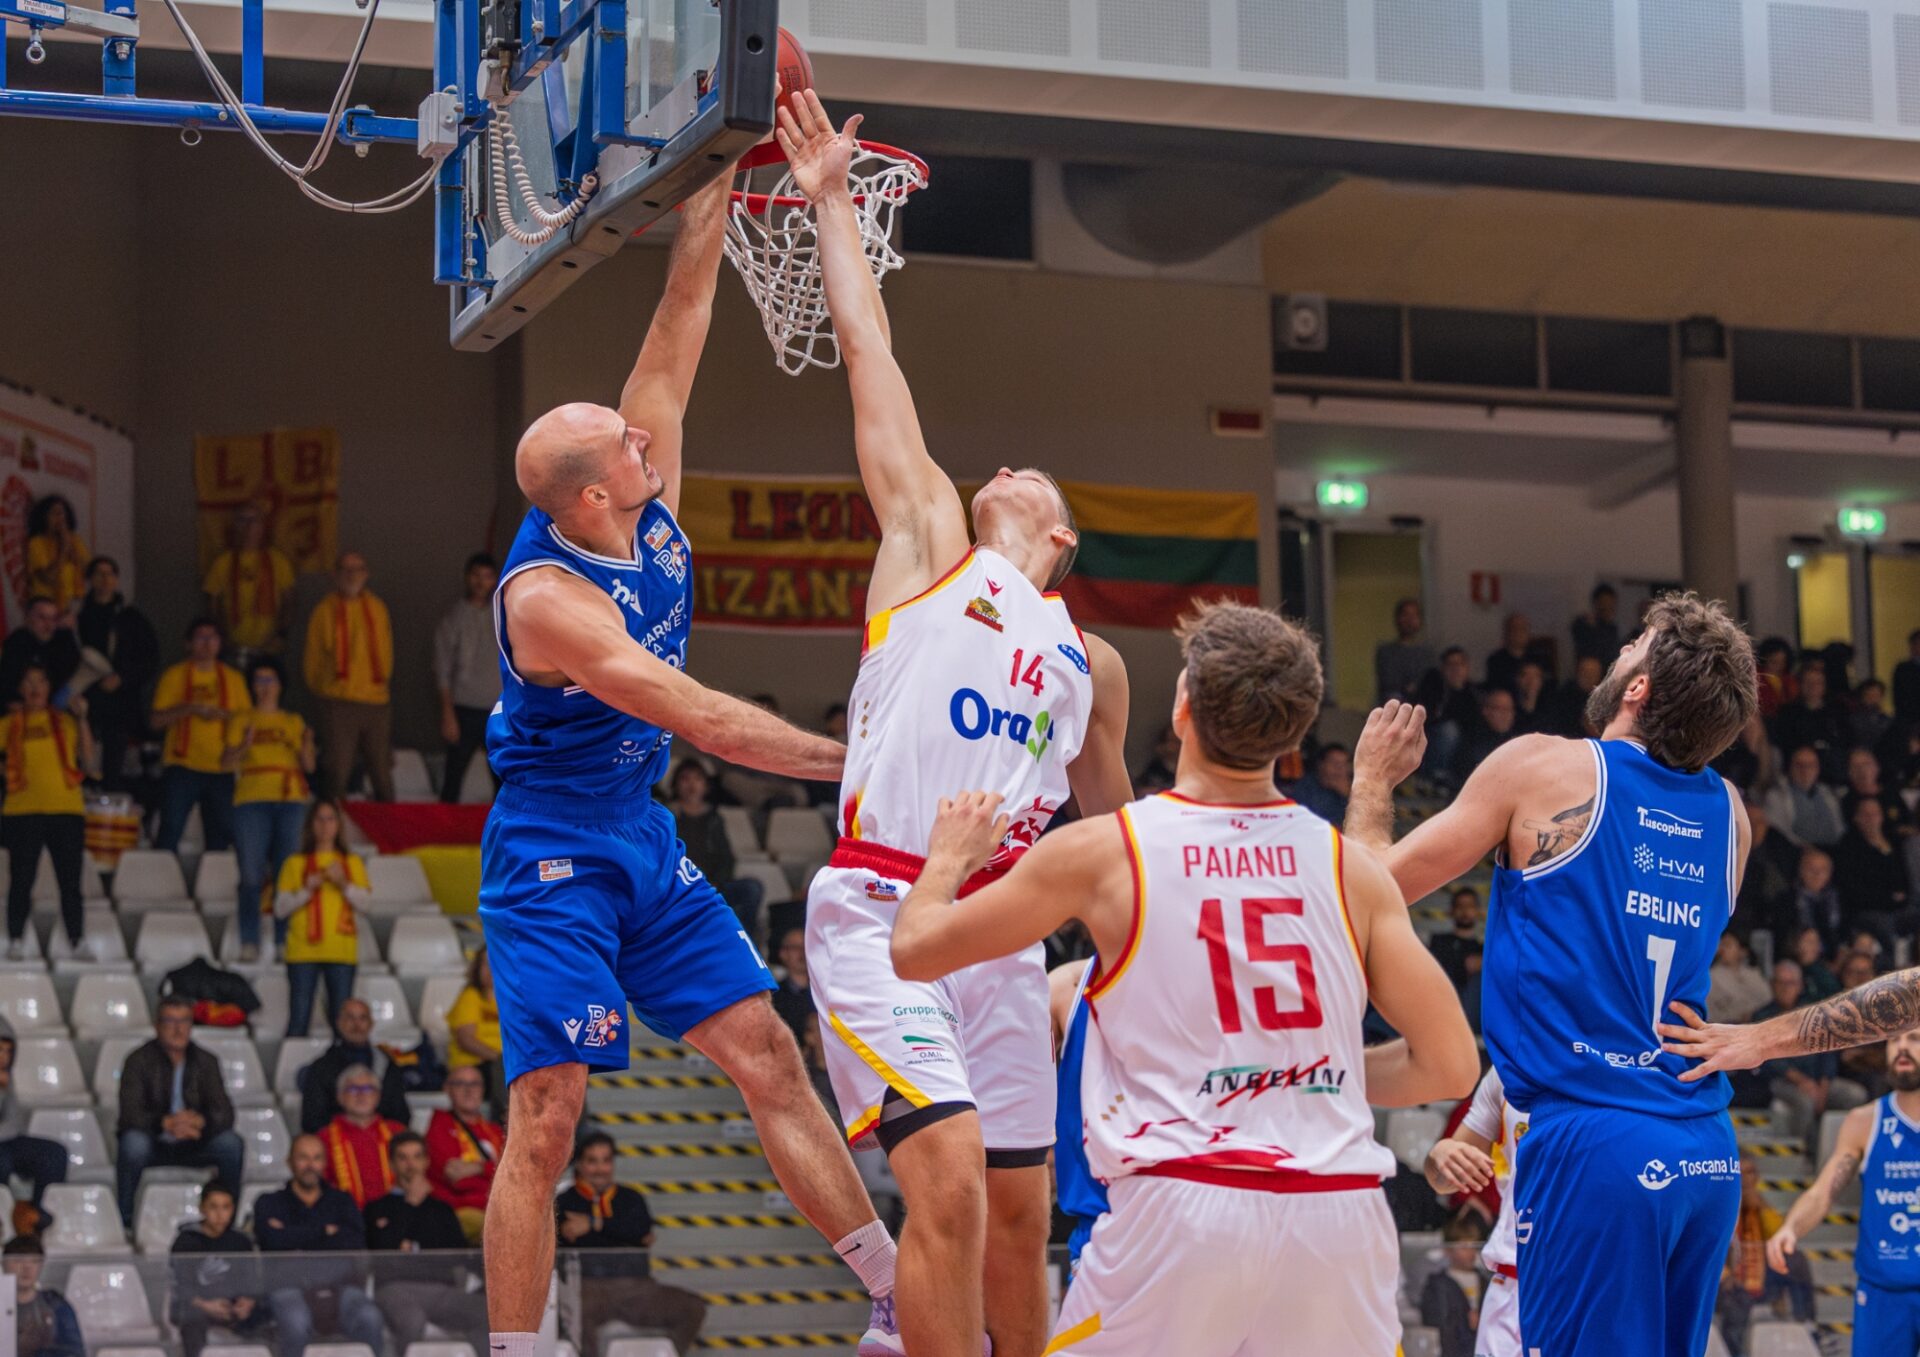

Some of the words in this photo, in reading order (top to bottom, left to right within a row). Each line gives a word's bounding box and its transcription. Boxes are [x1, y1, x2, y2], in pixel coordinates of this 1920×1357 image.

[731, 489, 883, 541] LEON
[694, 566, 868, 618] IZAN
[1010, 648, 1045, 697] 14
[1637, 806, 1702, 839] Tuscopharm
[1182, 845, 1297, 878] PAIANO
[1659, 857, 1704, 878] HVM
[1625, 889, 1701, 928] EBELING
[1197, 898, 1323, 1034] 15
[893, 1006, 937, 1017] Gruppo
[1196, 1066, 1346, 1098] ANGELINI
[1882, 1117, 1898, 1135] 17
[1679, 1160, 1727, 1178] Toscana
